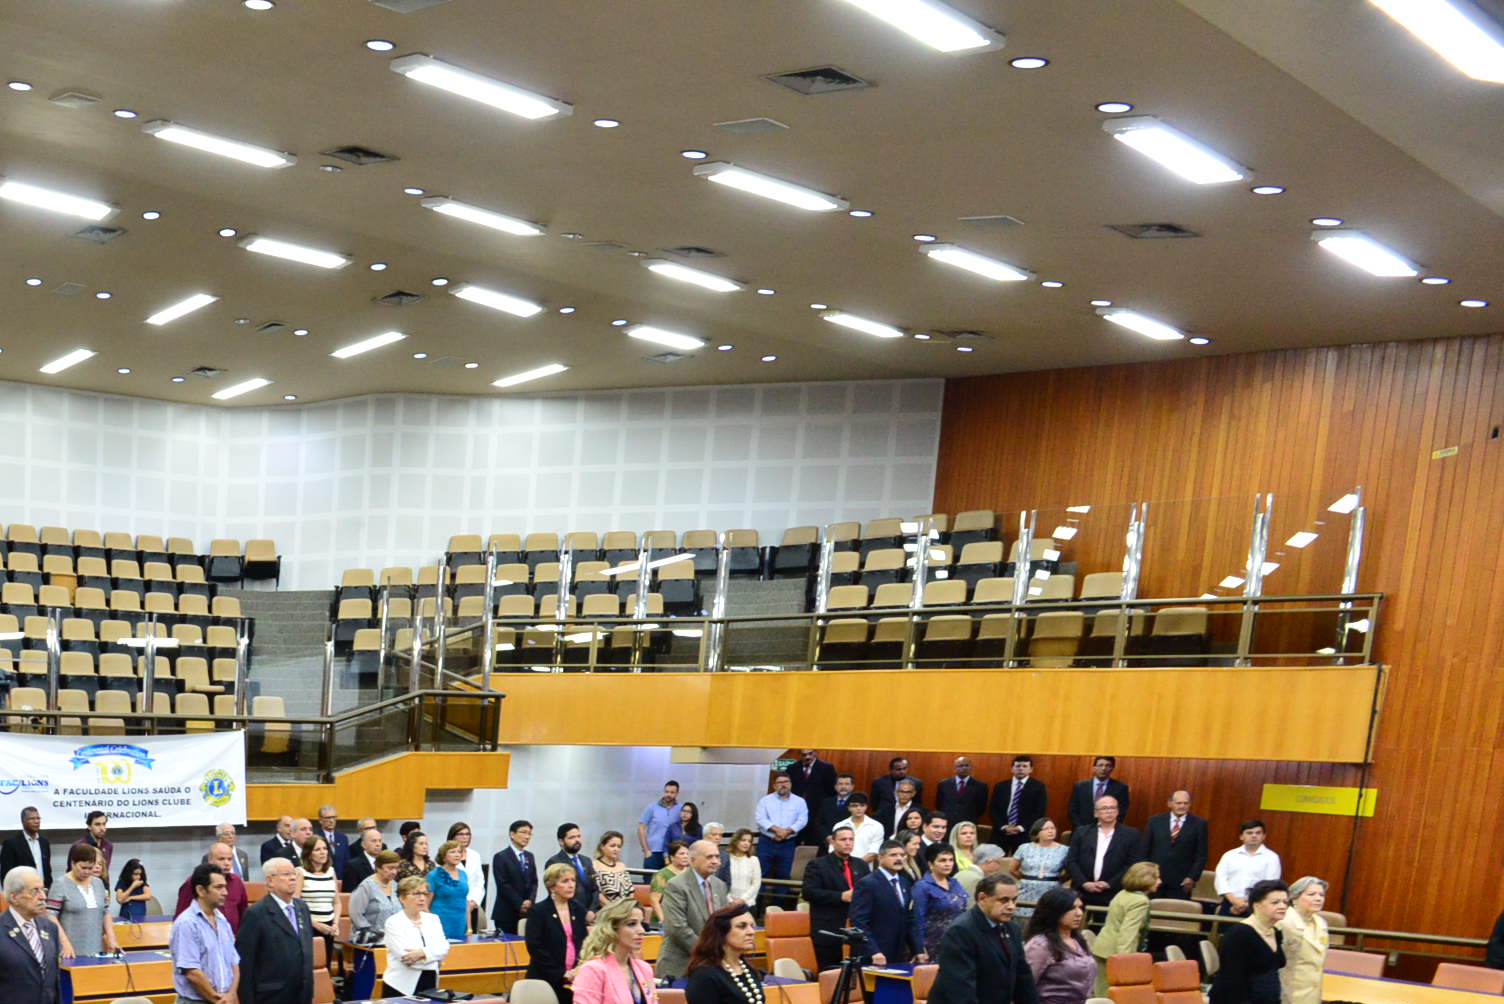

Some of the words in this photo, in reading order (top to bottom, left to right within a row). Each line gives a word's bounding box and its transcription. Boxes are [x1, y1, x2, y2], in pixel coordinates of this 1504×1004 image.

[53, 788, 61, 796] A
[63, 787, 119, 796] FACULDADE
[122, 787, 149, 795] LIONS
[184, 786, 192, 794] O
[117, 799, 130, 807] DO
[161, 798, 191, 806] CLUBE
